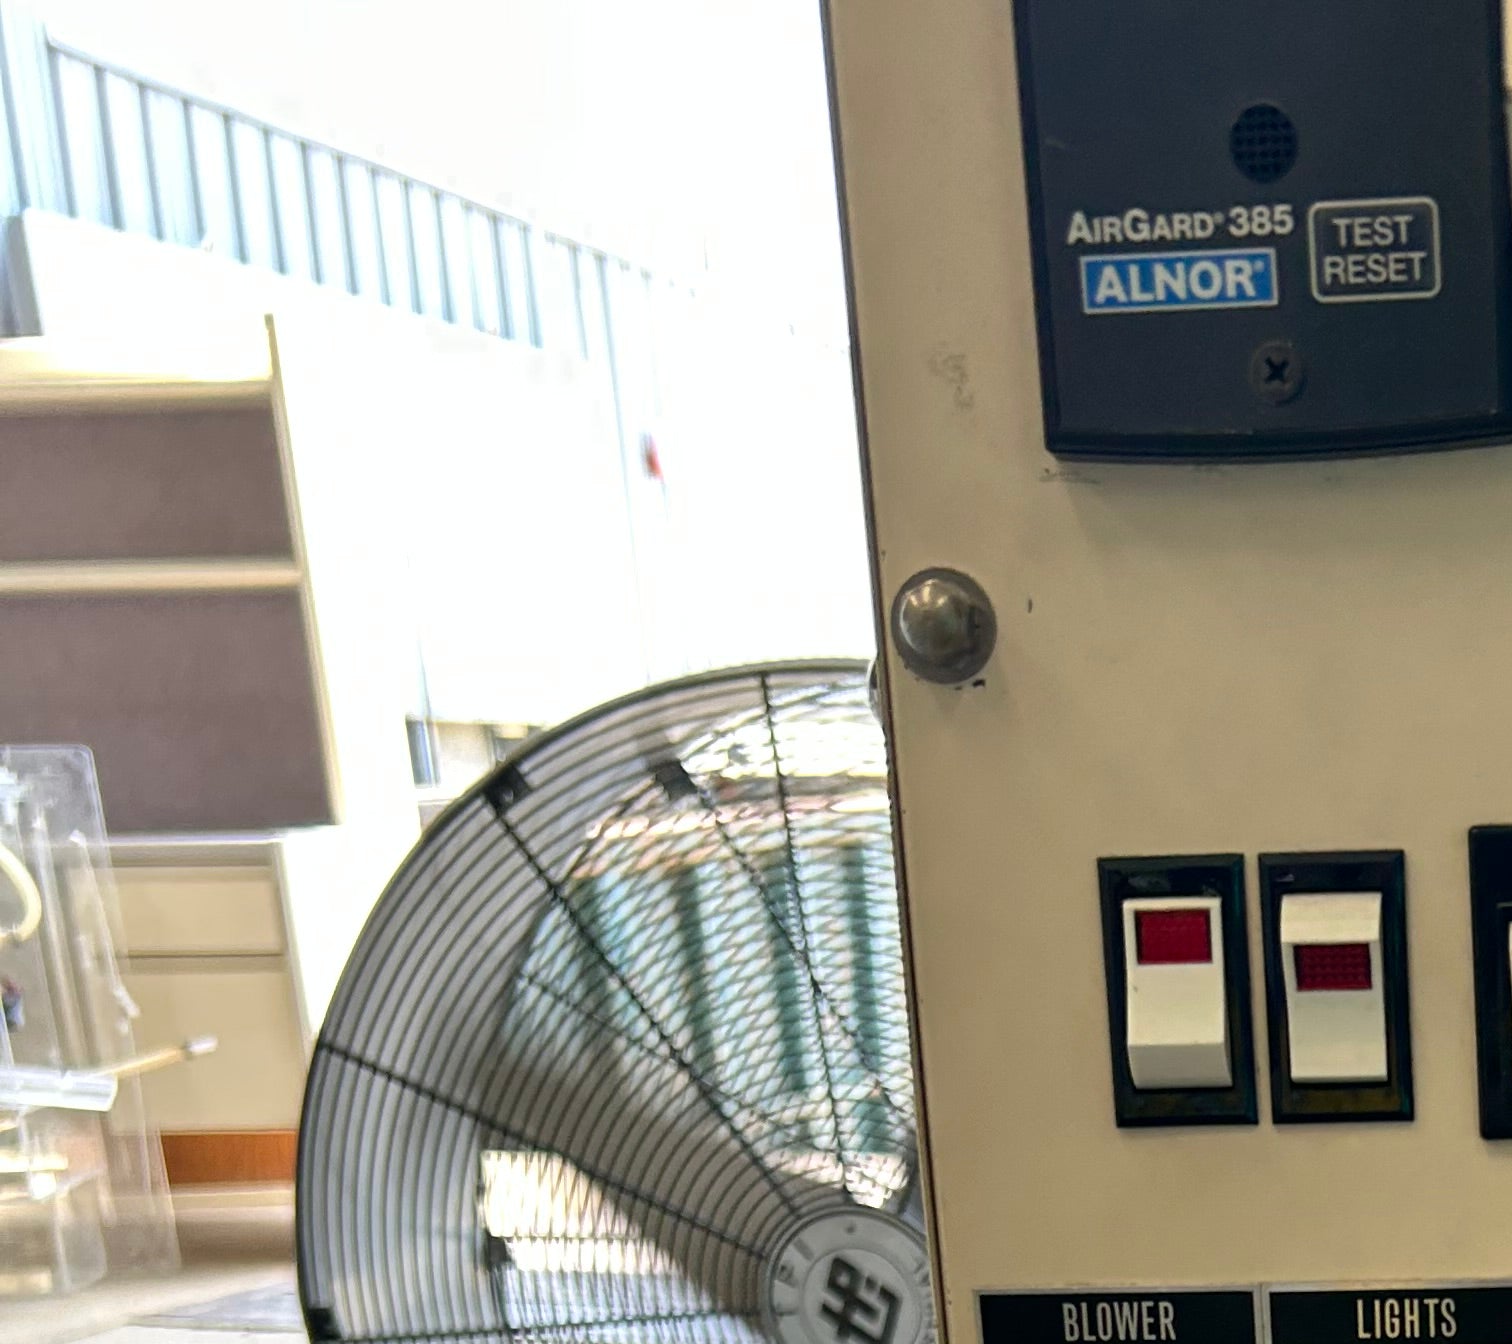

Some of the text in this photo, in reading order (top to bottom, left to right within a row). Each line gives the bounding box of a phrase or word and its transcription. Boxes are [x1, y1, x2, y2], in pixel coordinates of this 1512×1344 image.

[1227, 204, 1294, 237] 385
[1332, 215, 1413, 248] TEST
[1094, 258, 1257, 304] ALNOR
[1323, 251, 1427, 286] RESET
[1062, 1300, 1177, 1343] BLOWER
[1356, 1297, 1459, 1341] LIGHTS
